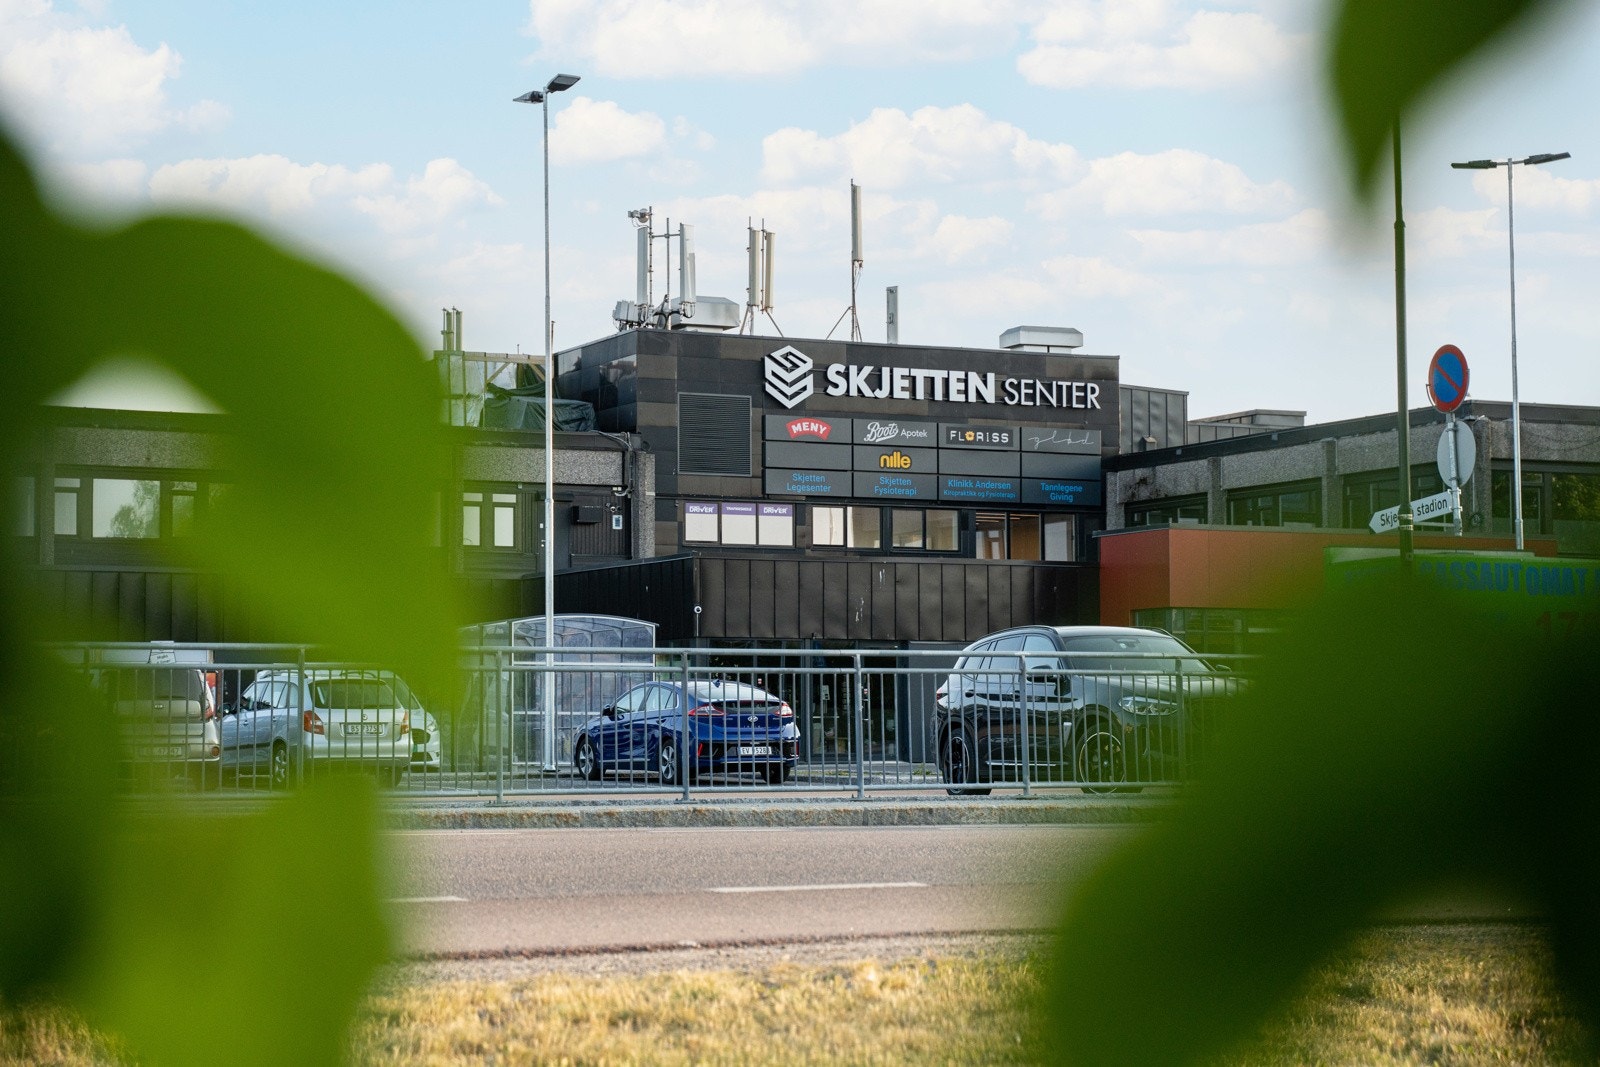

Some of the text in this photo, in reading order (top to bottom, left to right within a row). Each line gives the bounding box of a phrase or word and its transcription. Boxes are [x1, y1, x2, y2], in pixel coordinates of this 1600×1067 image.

[826, 363, 1101, 409] SKJETTEN SENTER
[791, 421, 828, 435] MENY
[863, 421, 928, 443] Boots Apotek
[879, 450, 912, 469] nille
[792, 473, 826, 484] Skjetten
[879, 476, 912, 488] Skjetten
[947, 479, 1012, 490] Klinikk Andersen
[786, 482, 832, 495] Legesenter
[874, 486, 917, 497] Fysioterapi
[1040, 482, 1083, 494] Tannlegene
[1049, 492, 1074, 503] Giving
[1416, 498, 1448, 516] stadion
